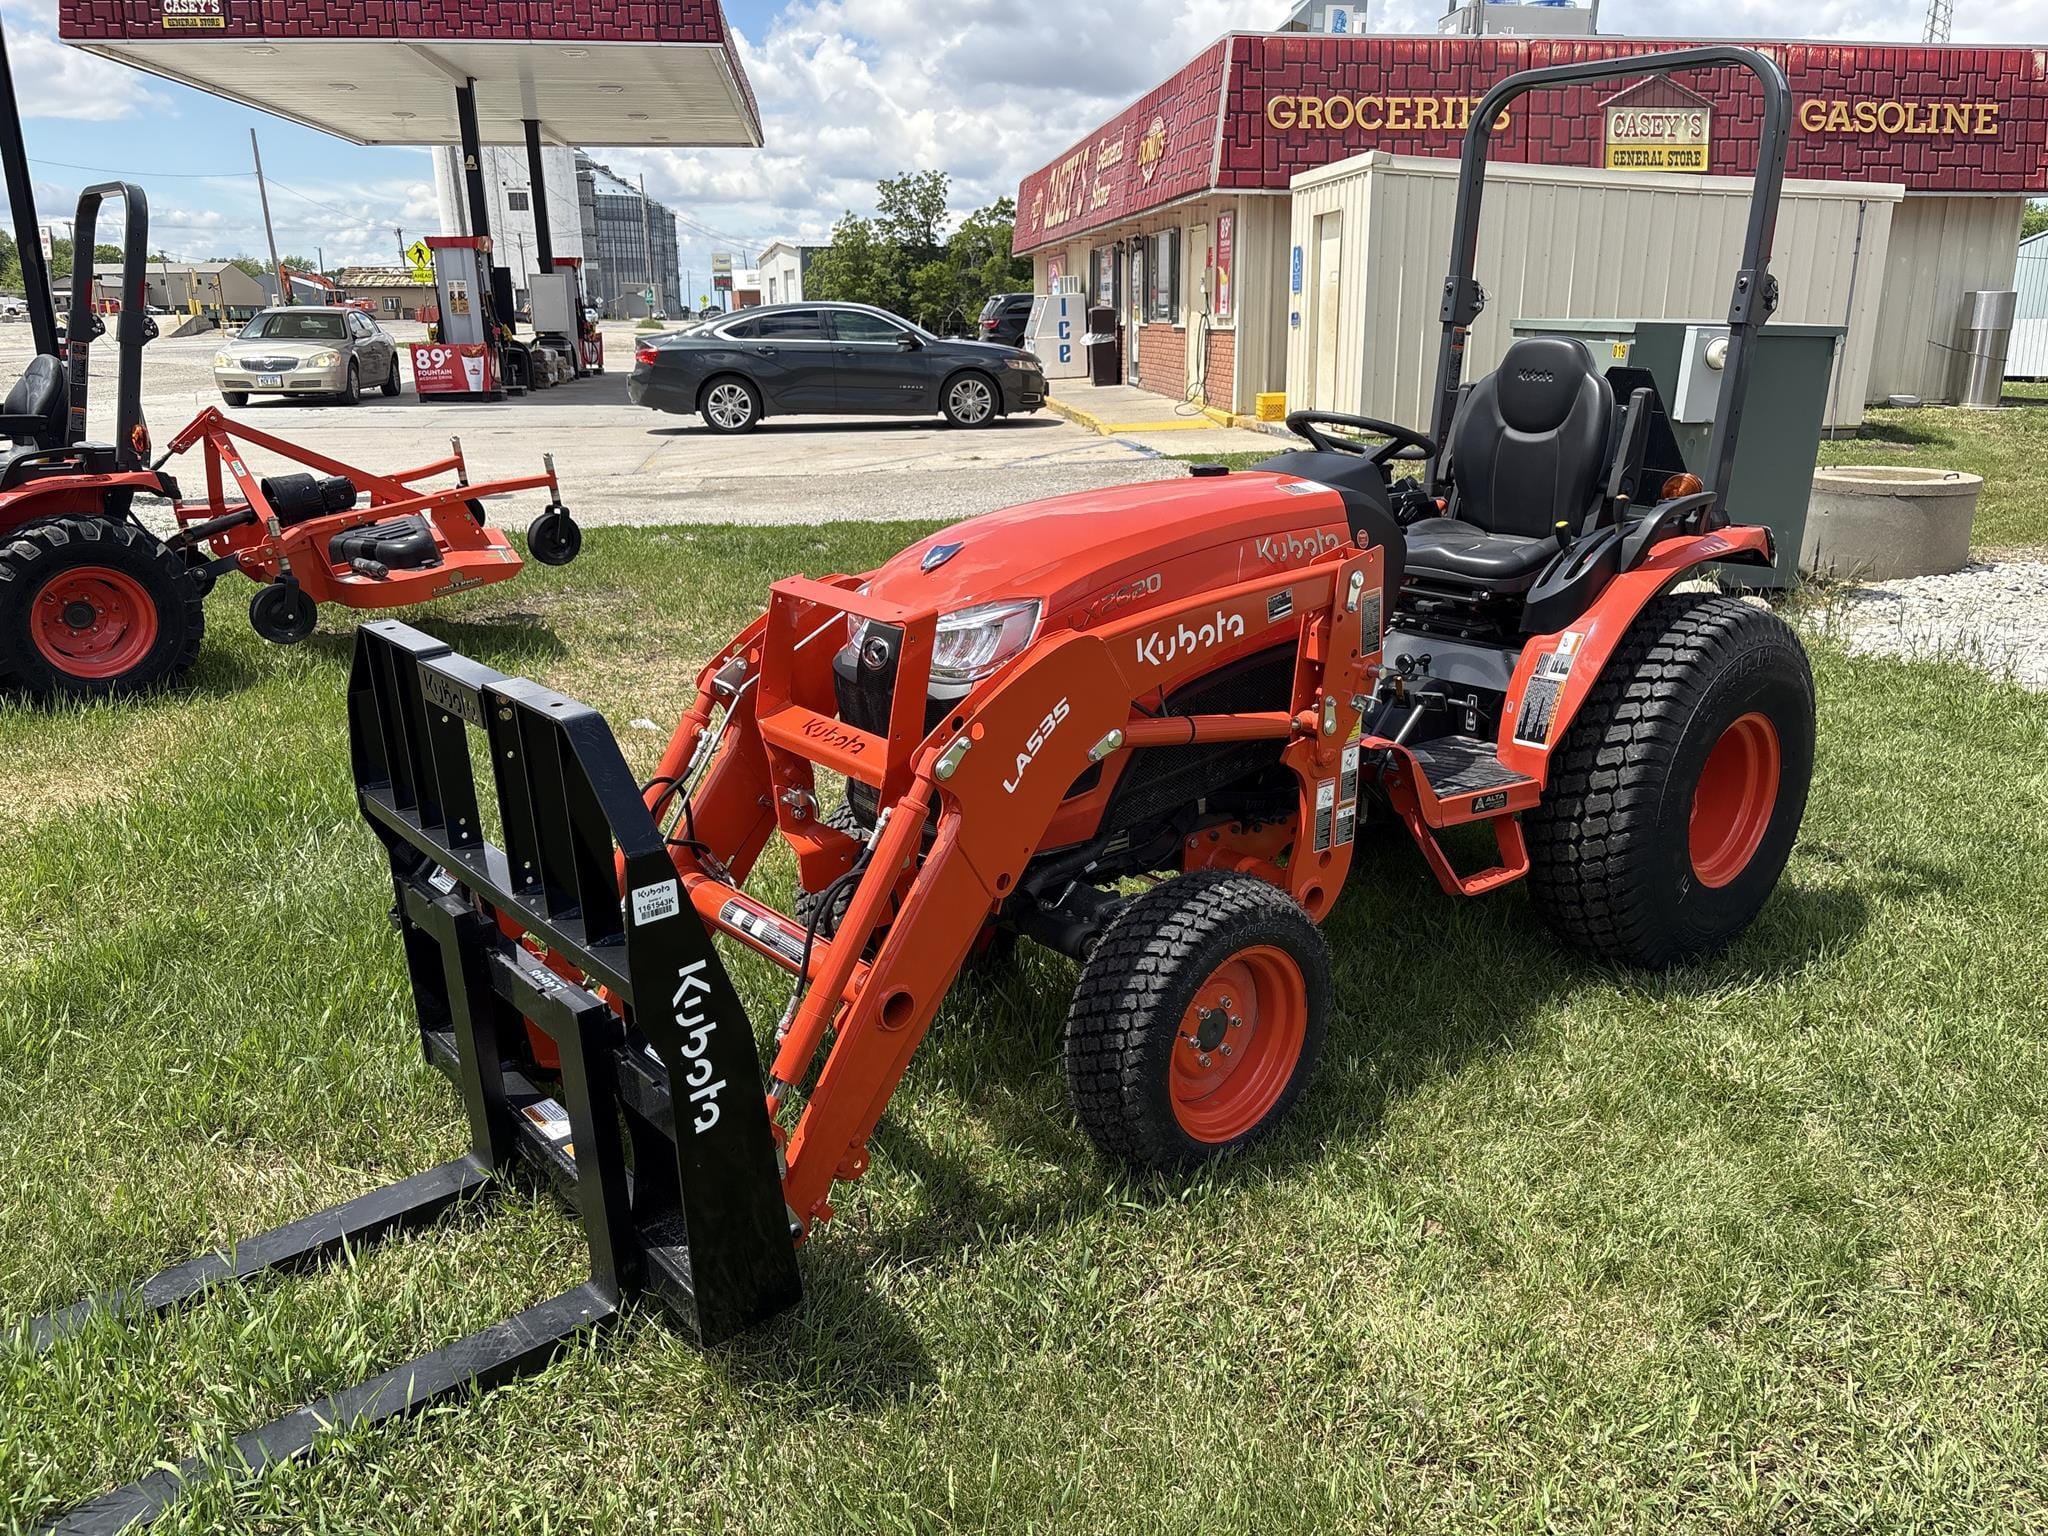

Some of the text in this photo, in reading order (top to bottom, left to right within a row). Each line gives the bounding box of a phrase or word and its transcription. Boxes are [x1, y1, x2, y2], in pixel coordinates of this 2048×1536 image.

[163, 0, 220, 14] CASEY'S
[168, 18, 220, 26] GENERAL STORE
[1612, 113, 1702, 138] CASEY'S
[1800, 99, 1999, 135] GASOLINE
[1613, 150, 1702, 167] GENERAL STORE
[1044, 145, 1091, 230] CASEY'S
[1096, 125, 1127, 173] General
[415, 348, 453, 370] 89¢
[1612, 344, 1627, 358] 019
[417, 368, 453, 377] FOUNTAIN
[1518, 368, 1554, 383] Kubota
[1255, 527, 1339, 564] Kubota
[1136, 610, 1245, 666] Kubota
[423, 670, 478, 723] Kubota
[801, 718, 866, 755] Kubota
[1002, 696, 1071, 794] LA535
[637, 885, 671, 898] Kubota
[638, 896, 675, 913] 1161543K
[672, 958, 728, 1135] Kubota
